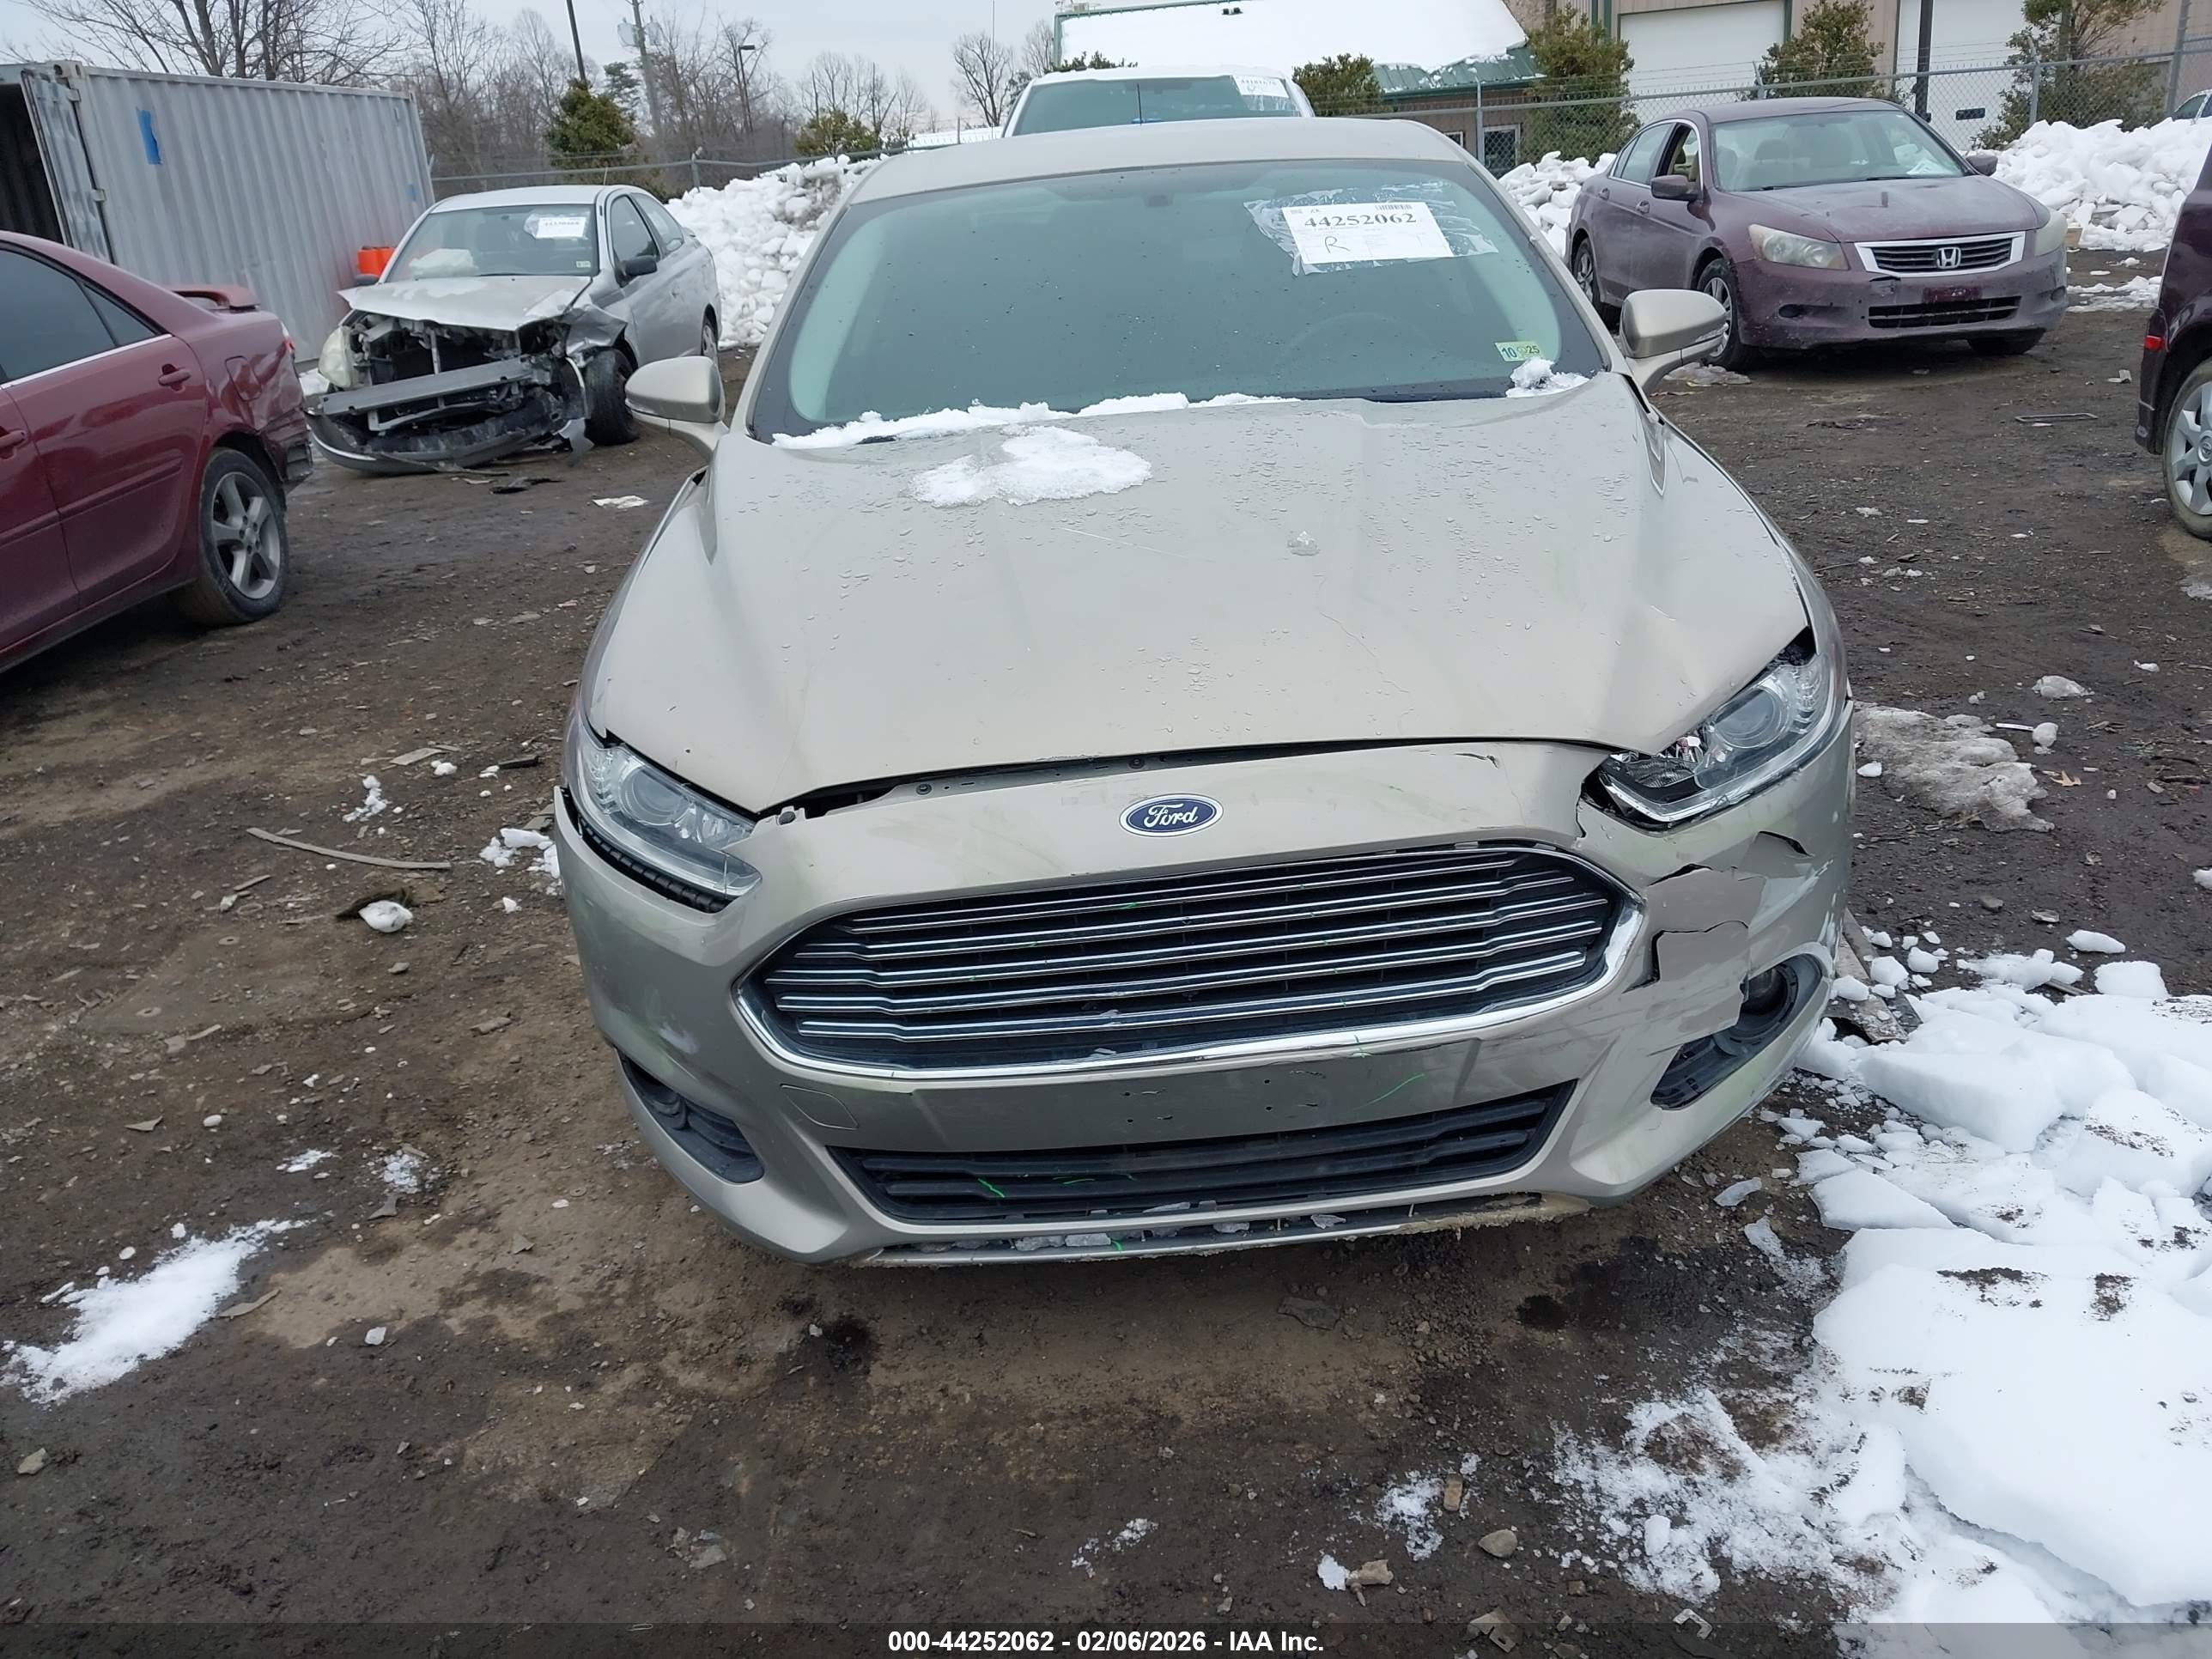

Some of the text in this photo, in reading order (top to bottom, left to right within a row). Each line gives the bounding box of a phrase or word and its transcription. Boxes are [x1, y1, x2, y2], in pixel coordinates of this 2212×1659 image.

[1304, 212, 1418, 228] 44252062
[1324, 234, 1352, 254] R
[1501, 345, 1540, 358] 10 25
[1143, 802, 1199, 828] Ford
